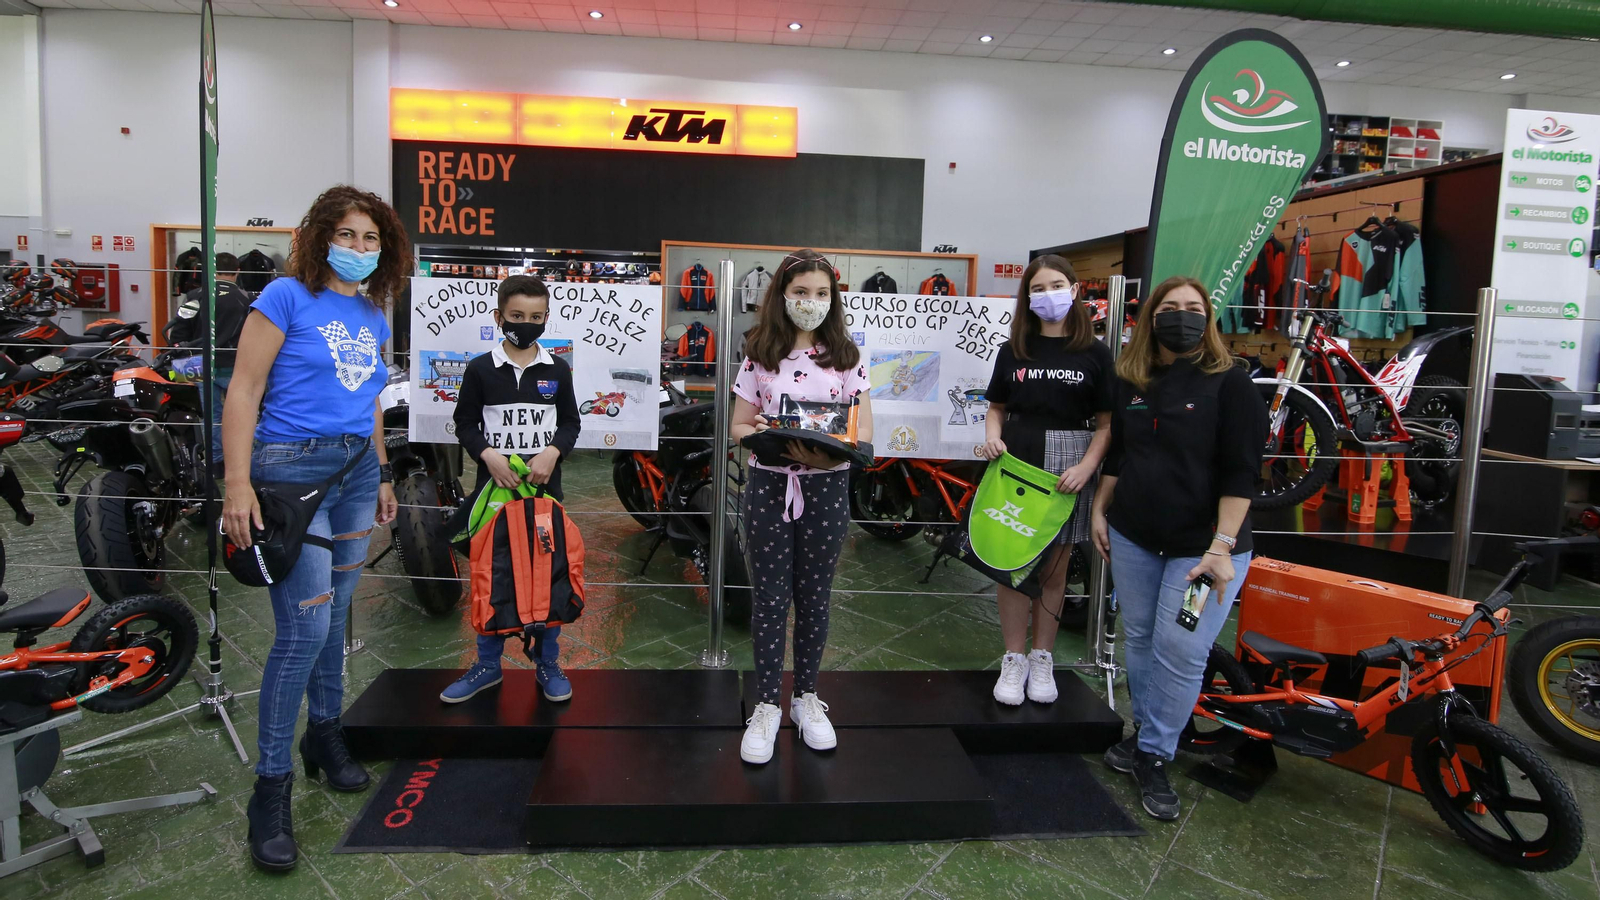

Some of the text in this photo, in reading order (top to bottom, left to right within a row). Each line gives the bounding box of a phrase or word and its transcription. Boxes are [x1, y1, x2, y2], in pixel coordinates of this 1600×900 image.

[623, 108, 726, 144] KTM
[1184, 138, 1306, 168] el Motorista
[1512, 148, 1592, 163] el Motorista
[418, 150, 517, 181] READY
[1536, 177, 1563, 186] MOTOS
[418, 179, 457, 207] TO
[246, 217, 273, 227] KTM
[418, 206, 495, 235] RACE
[1522, 209, 1568, 219] RECAMBIOS
[933, 244, 958, 253] KTM
[1523, 241, 1562, 251] BOUTIQUE
[428, 280, 498, 309] CONCUR
[629, 299, 654, 321] DE
[1516, 304, 1559, 315] M.OCASIÓN
[842, 296, 1012, 325] NCURSO ESCOLAR D
[427, 300, 488, 336] DIBUJO
[560, 304, 582, 320] GP
[589, 307, 646, 342] JEREZ
[863, 314, 917, 329] MOTO
[926, 315, 948, 330] GP
[582, 328, 626, 356] 2021
[955, 335, 994, 362] 2021
[341, 367, 354, 387] JEREZ
[1012, 369, 1084, 381] I MY WORLD
[502, 408, 546, 426] NEW
[899, 431, 906, 445] 1
[982, 507, 1038, 537] AXXIS
[1259, 586, 1278, 595] RADICAL
[1278, 591, 1299, 600] TRAINING
[1428, 613, 1445, 621] READY
[383, 758, 443, 829] YMCO
